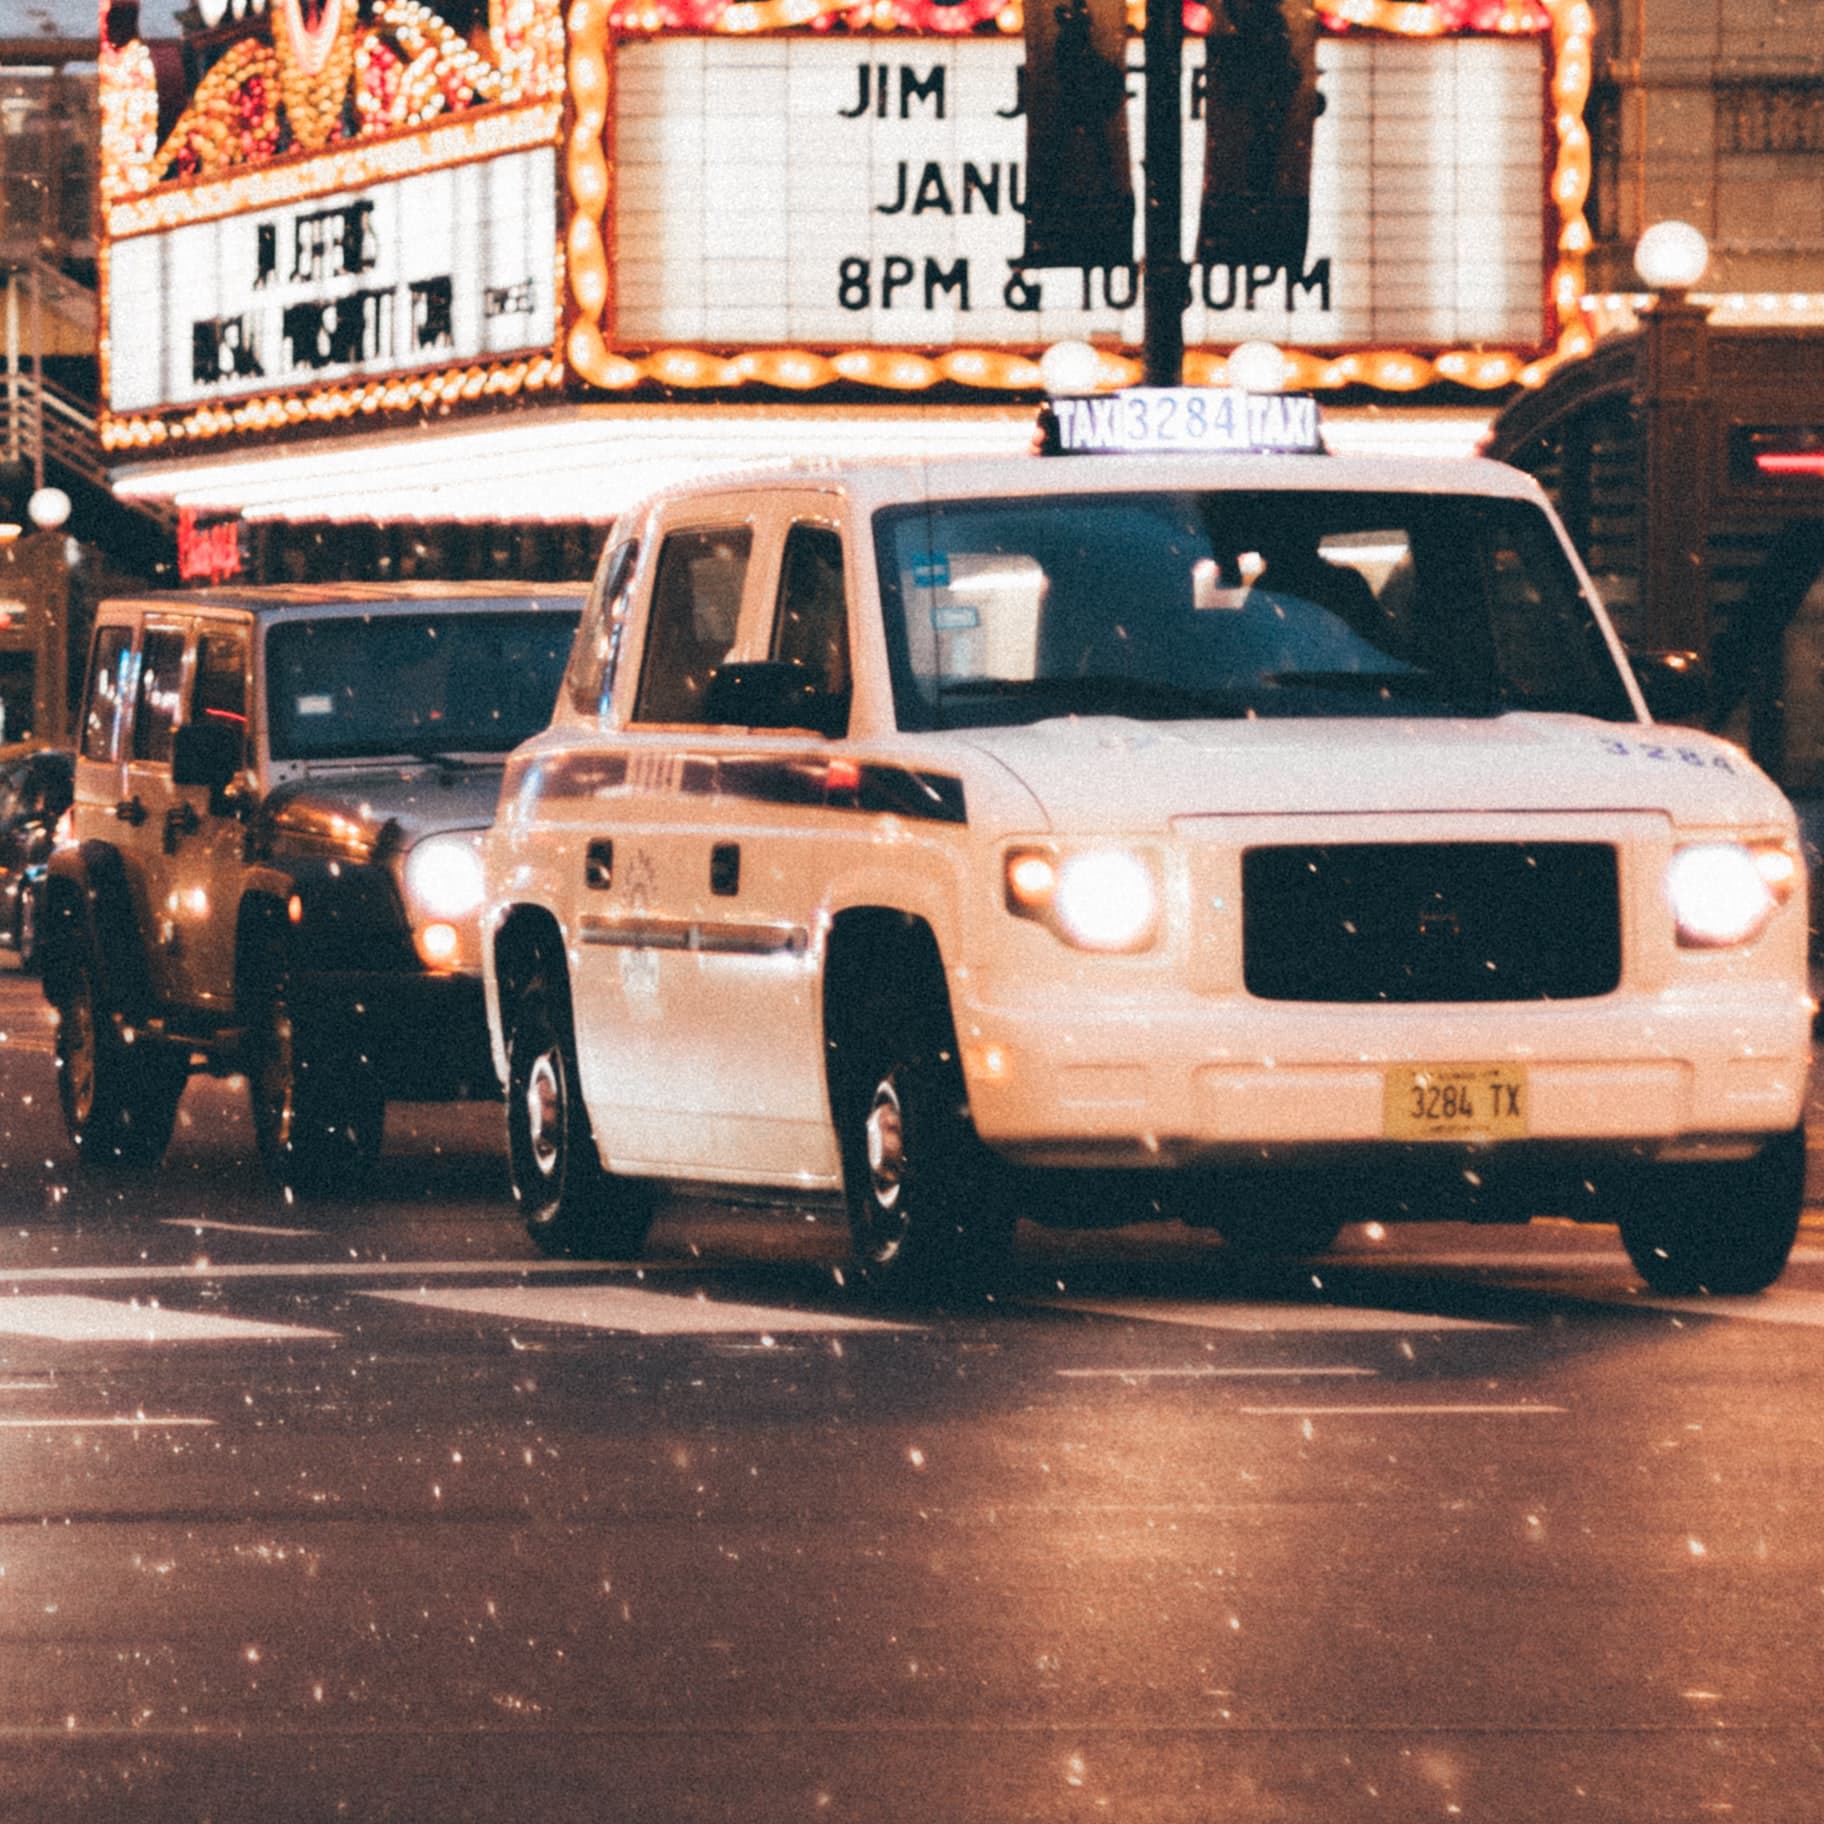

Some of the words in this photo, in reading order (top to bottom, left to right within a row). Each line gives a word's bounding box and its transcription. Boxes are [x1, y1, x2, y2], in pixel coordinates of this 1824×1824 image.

[838, 64, 946, 121] JIM
[838, 255, 971, 312] 8PM
[1052, 398, 1121, 449] TAXI
[1127, 396, 1236, 441] 3284
[1248, 395, 1317, 448] TAXI
[1599, 737, 1736, 776] 3284
[1411, 1085, 1473, 1119] 3284
[1490, 1083, 1521, 1118] TX
